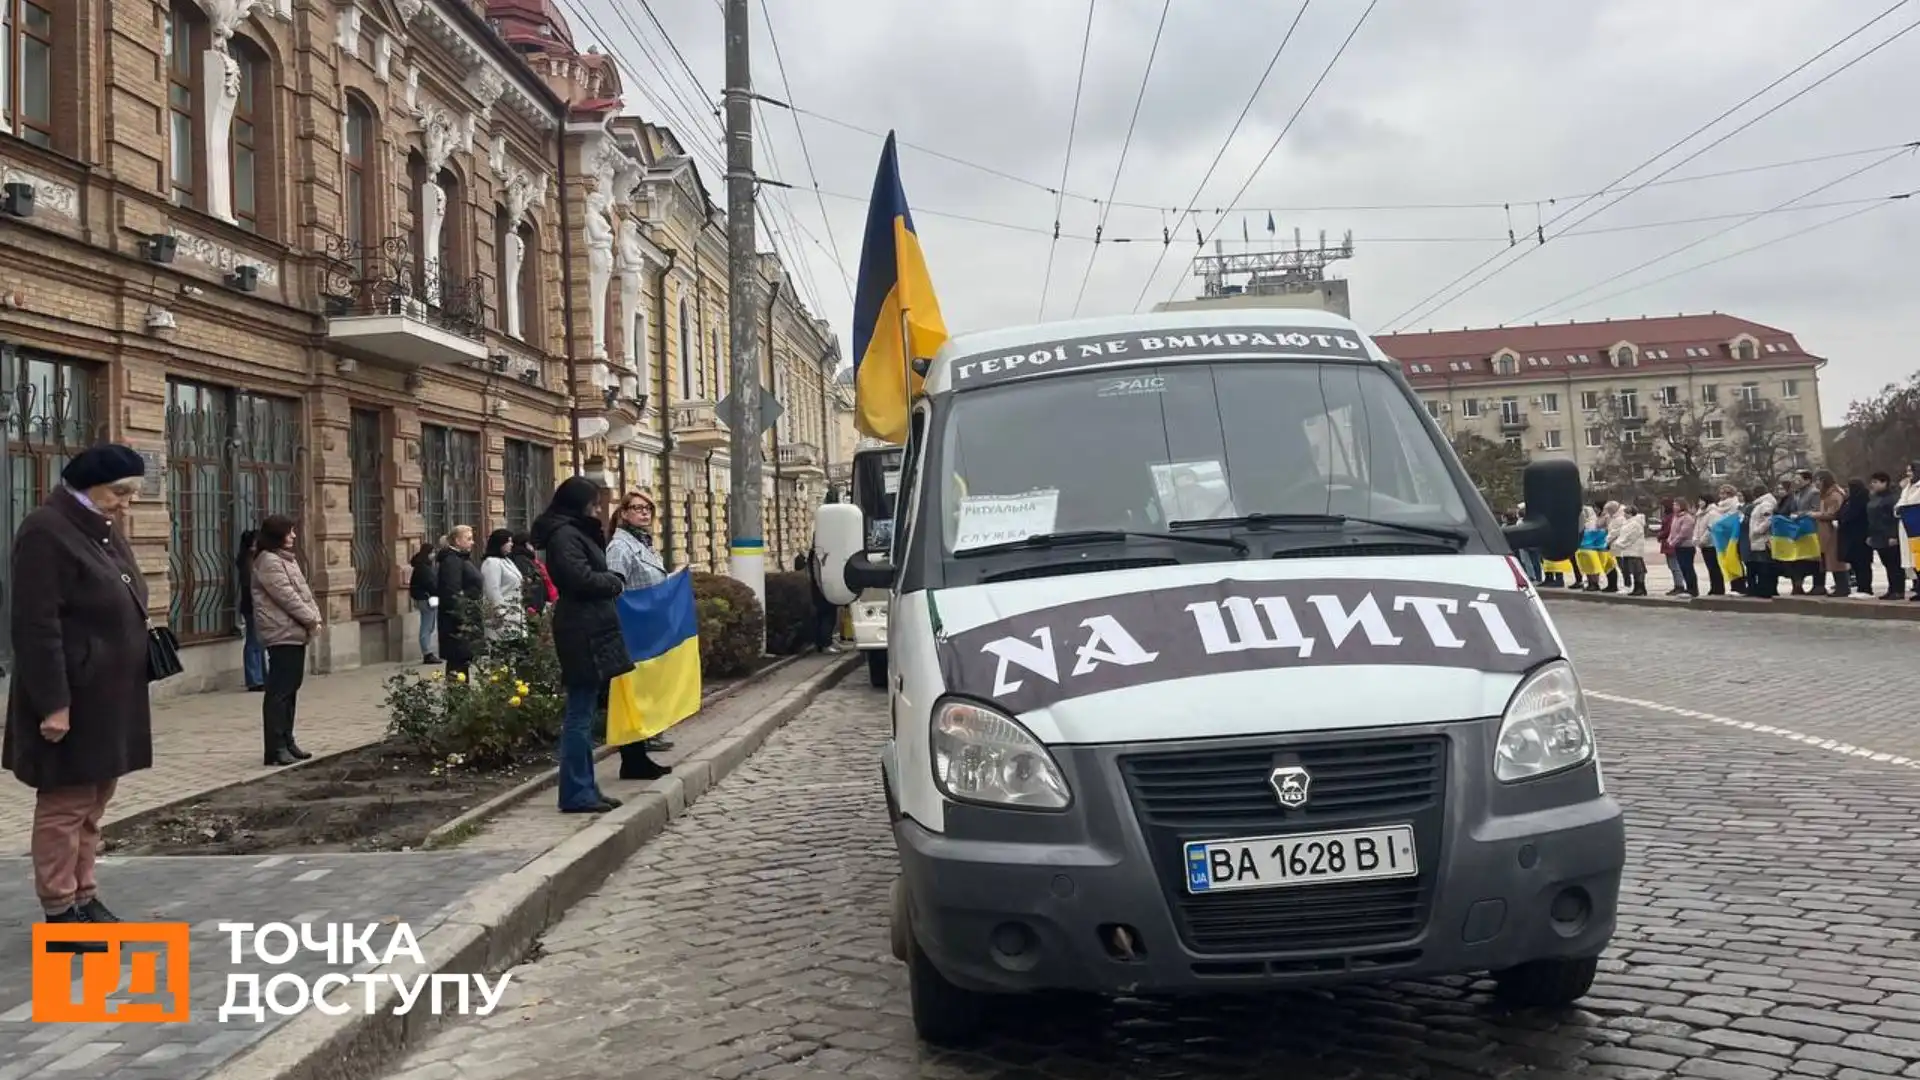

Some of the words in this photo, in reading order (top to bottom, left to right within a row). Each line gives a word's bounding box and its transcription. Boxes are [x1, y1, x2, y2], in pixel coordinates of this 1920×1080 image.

[958, 344, 1069, 379] ГЕРОЇ
[1139, 332, 1360, 350] ВМИРАЮТЬ
[1184, 591, 1530, 658] ЩИТІ
[1191, 872, 1208, 885] UA
[1270, 839, 1347, 878] 1628
